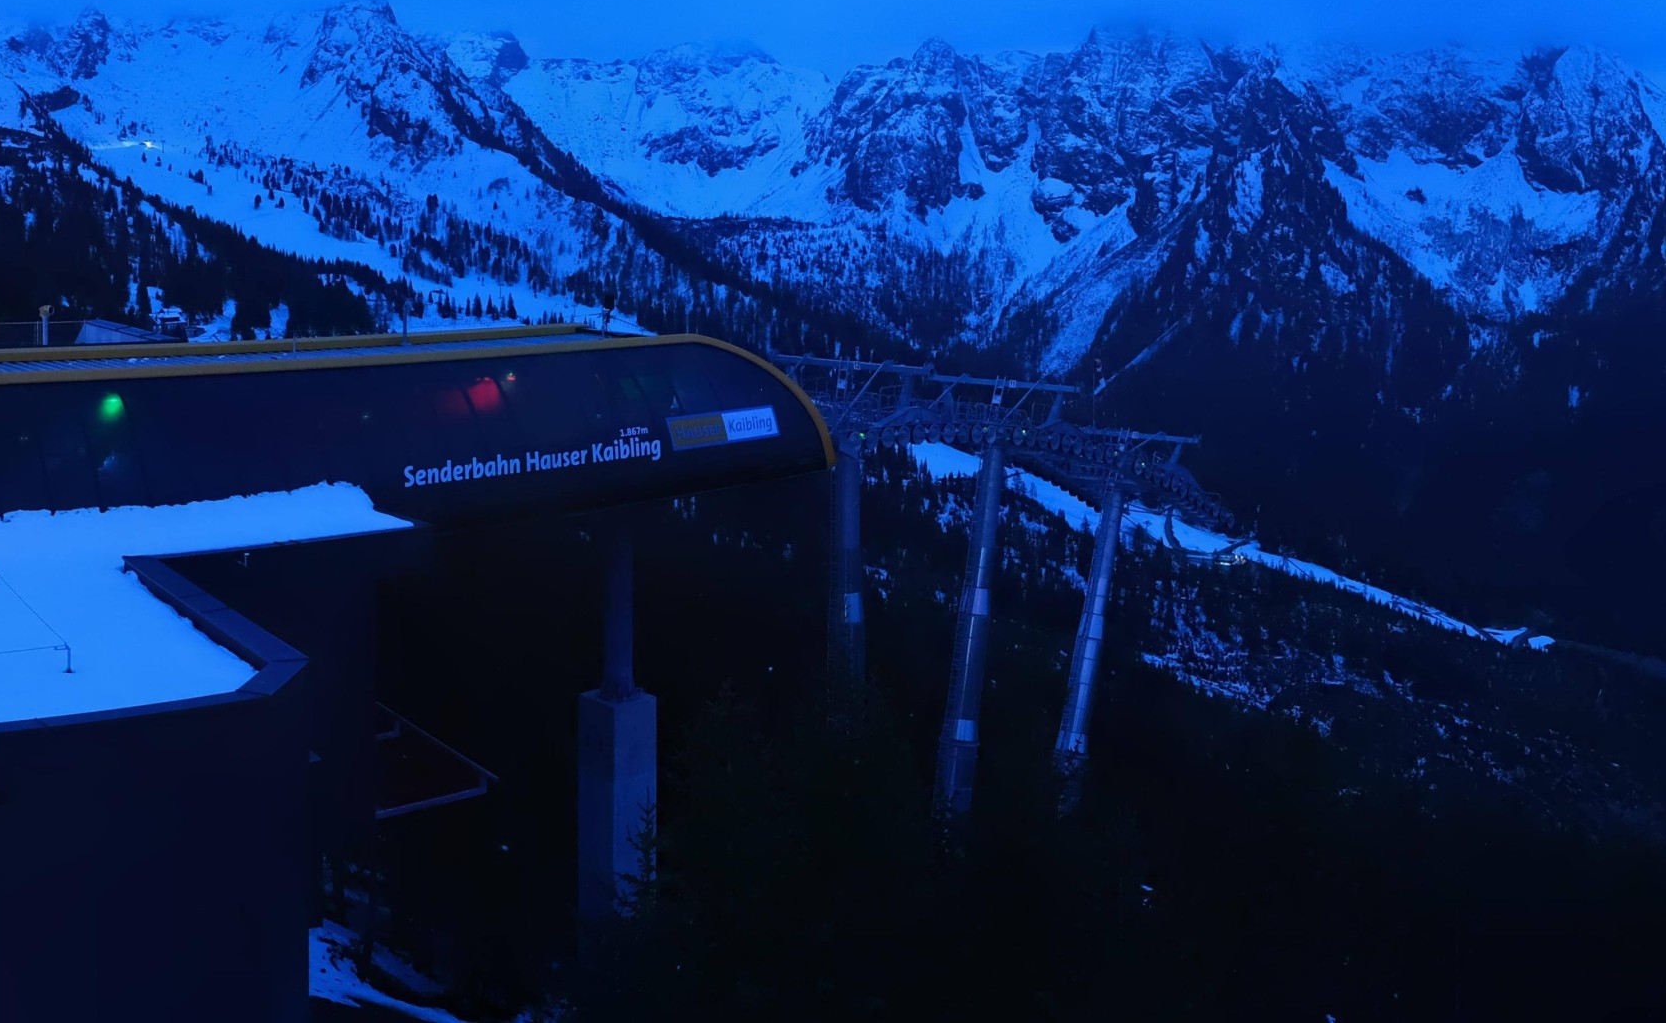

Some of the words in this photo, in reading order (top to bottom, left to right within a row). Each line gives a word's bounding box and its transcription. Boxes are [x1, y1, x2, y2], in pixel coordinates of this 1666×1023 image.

[619, 427, 649, 437] 1.867m
[728, 415, 774, 434] Kaibling
[403, 454, 521, 488] Senderbahn
[526, 448, 588, 472] Hauser
[592, 437, 662, 463] Kaibling
